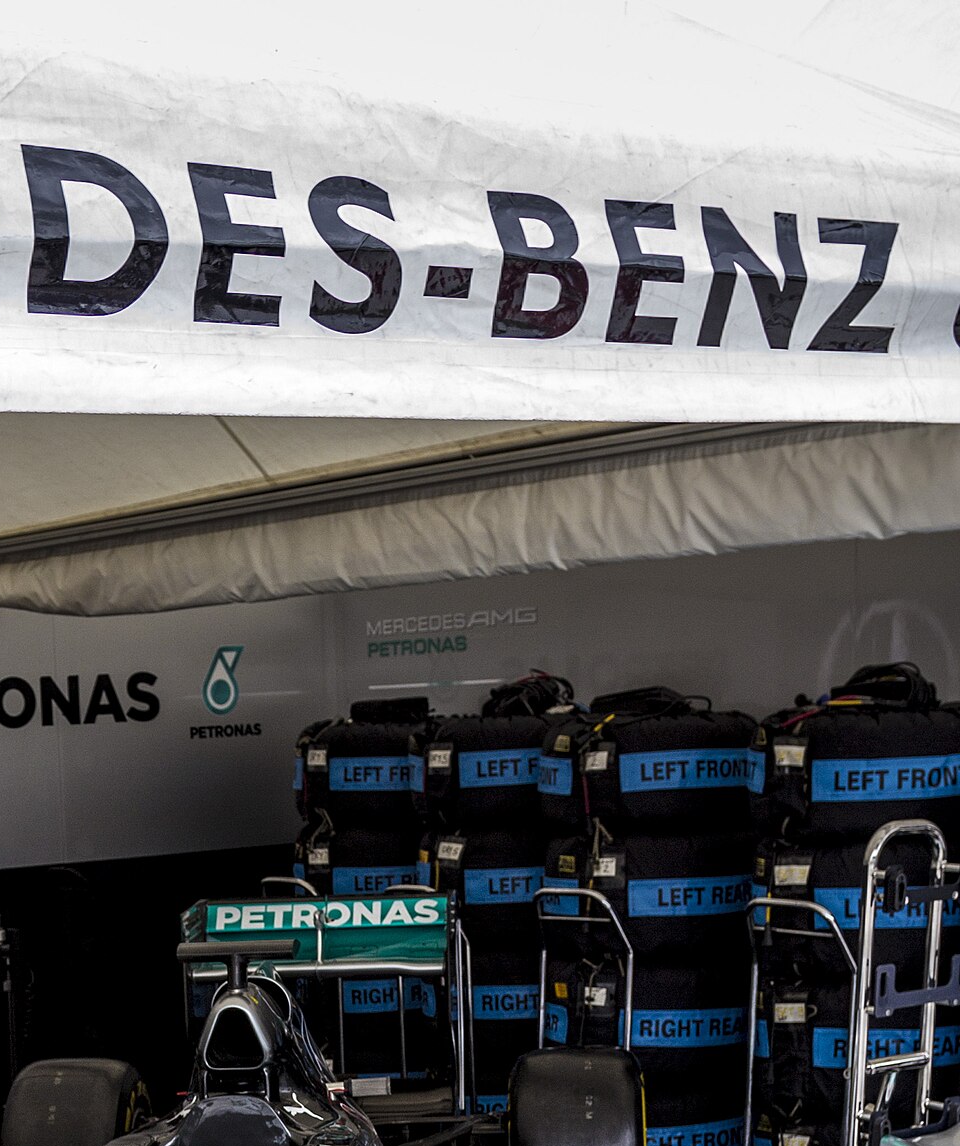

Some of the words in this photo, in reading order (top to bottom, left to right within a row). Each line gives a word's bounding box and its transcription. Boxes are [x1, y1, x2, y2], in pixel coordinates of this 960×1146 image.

[367, 635, 468, 657] PETRONAS
[189, 722, 262, 739] PETRONAS
[343, 766, 383, 783] LEFT
[476, 758, 520, 778] LEFT
[640, 761, 689, 782] LEFT
[834, 770, 889, 791] LEFT
[488, 876, 531, 896] LEFT
[657, 886, 705, 908] LEFT
[215, 899, 440, 931] PETRONAS
[640, 1018, 704, 1038] RIGHT
